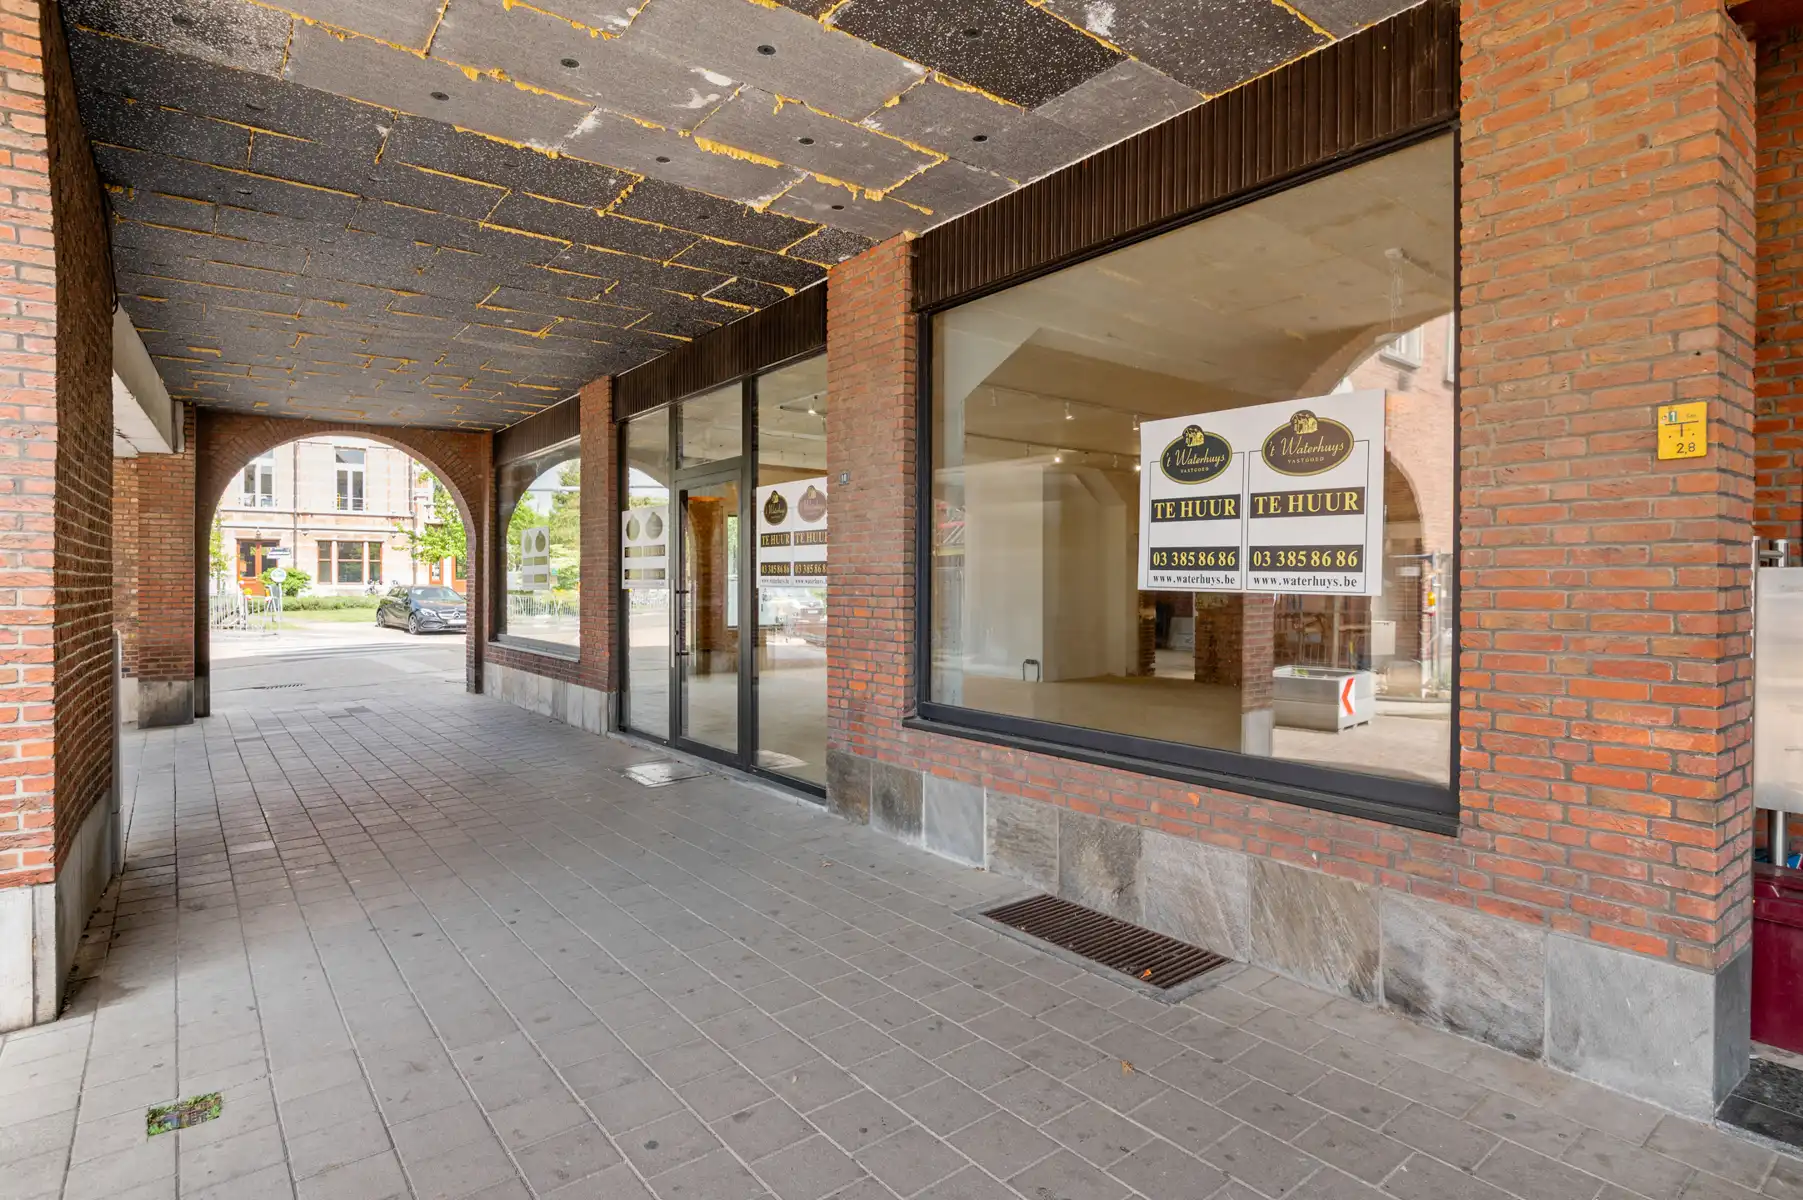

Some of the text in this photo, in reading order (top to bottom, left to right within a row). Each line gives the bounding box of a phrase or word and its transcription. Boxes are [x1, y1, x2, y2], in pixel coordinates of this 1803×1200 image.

[1280, 435, 1344, 457] Waterhuys
[1175, 447, 1225, 467] Waterhuys
[1154, 498, 1236, 519] TE HUUR
[1254, 491, 1359, 514] TE HUUR
[761, 533, 790, 546] TE HUUR
[795, 532, 805, 544] TE
[1153, 551, 1236, 566] 03 385 86 86
[1253, 550, 1358, 567] 03 385 86 86
[1153, 573, 1236, 586] www.waterhuys.be
[1253, 574, 1358, 588] www.waterhuys.be
